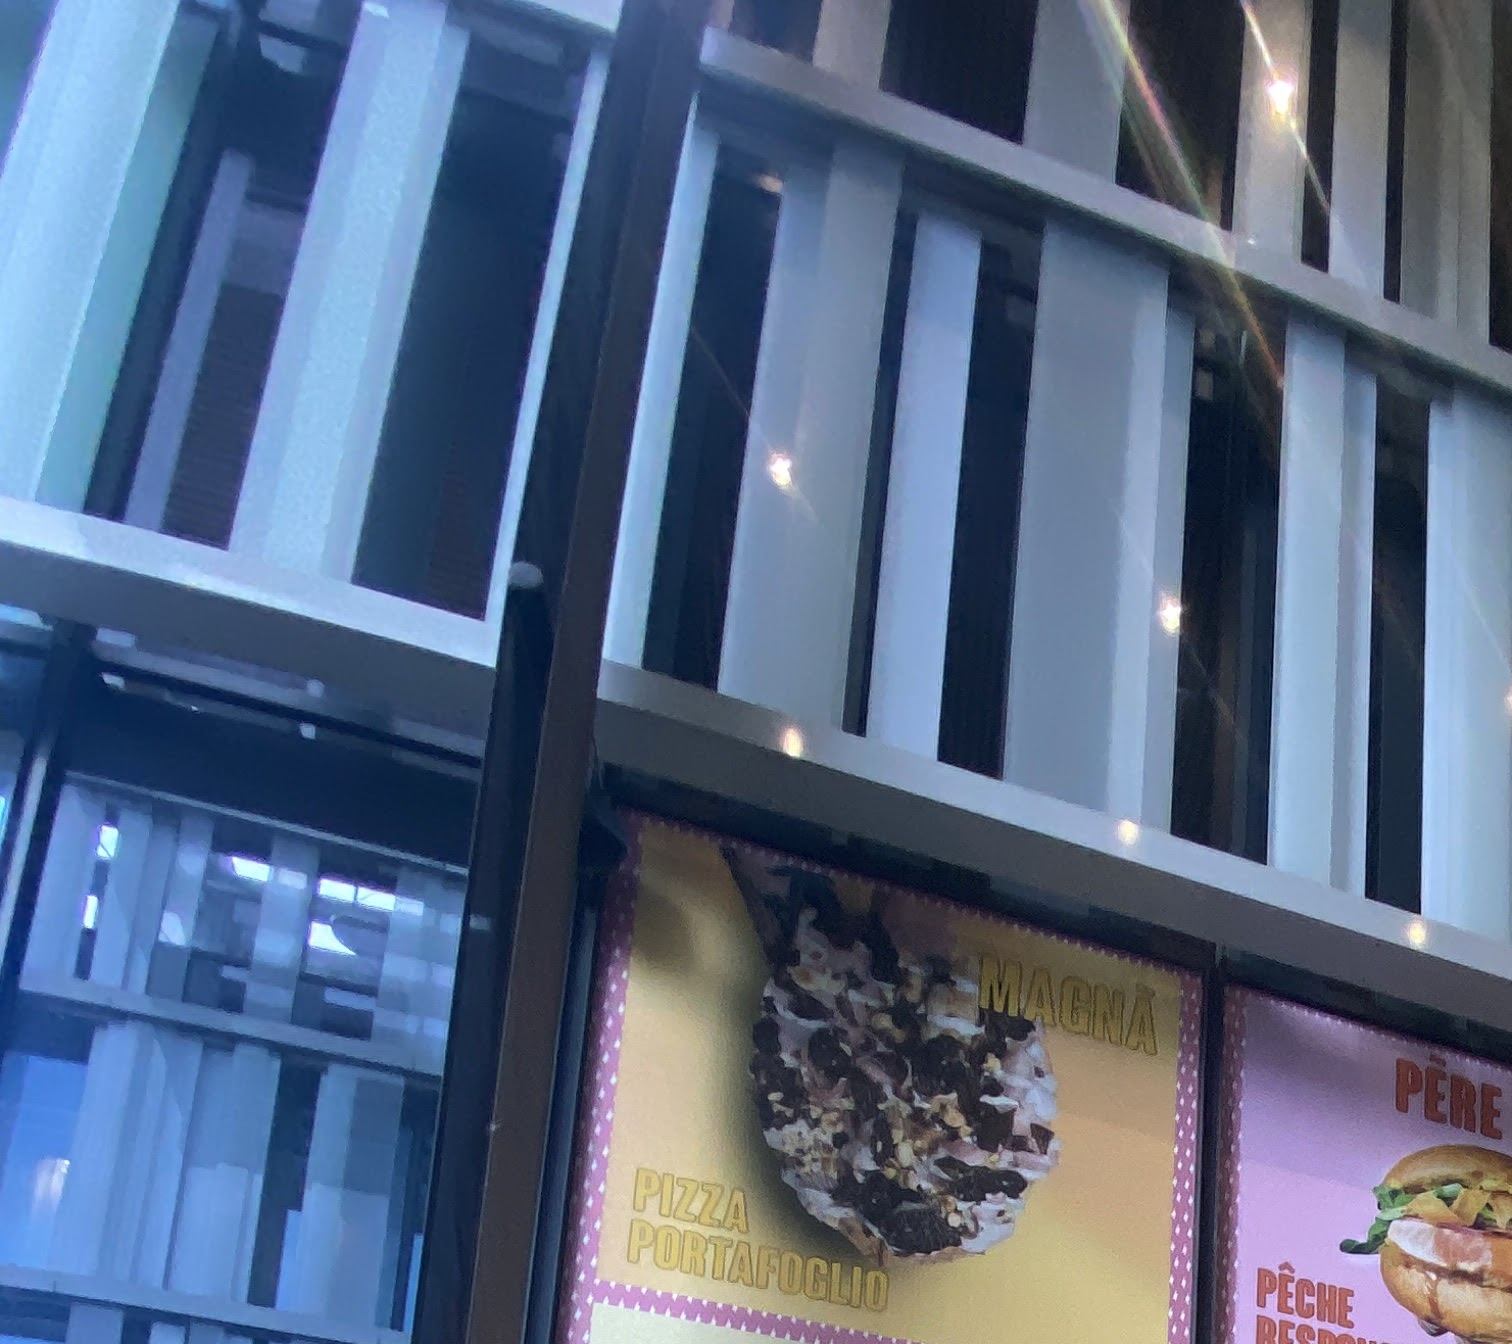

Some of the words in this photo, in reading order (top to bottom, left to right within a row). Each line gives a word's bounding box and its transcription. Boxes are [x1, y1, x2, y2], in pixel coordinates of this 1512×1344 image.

[633, 1167, 748, 1234] PIZZA
[627, 1219, 890, 1312] PORTAFOGLIO
[1256, 1262, 1354, 1329] PÊCHE
